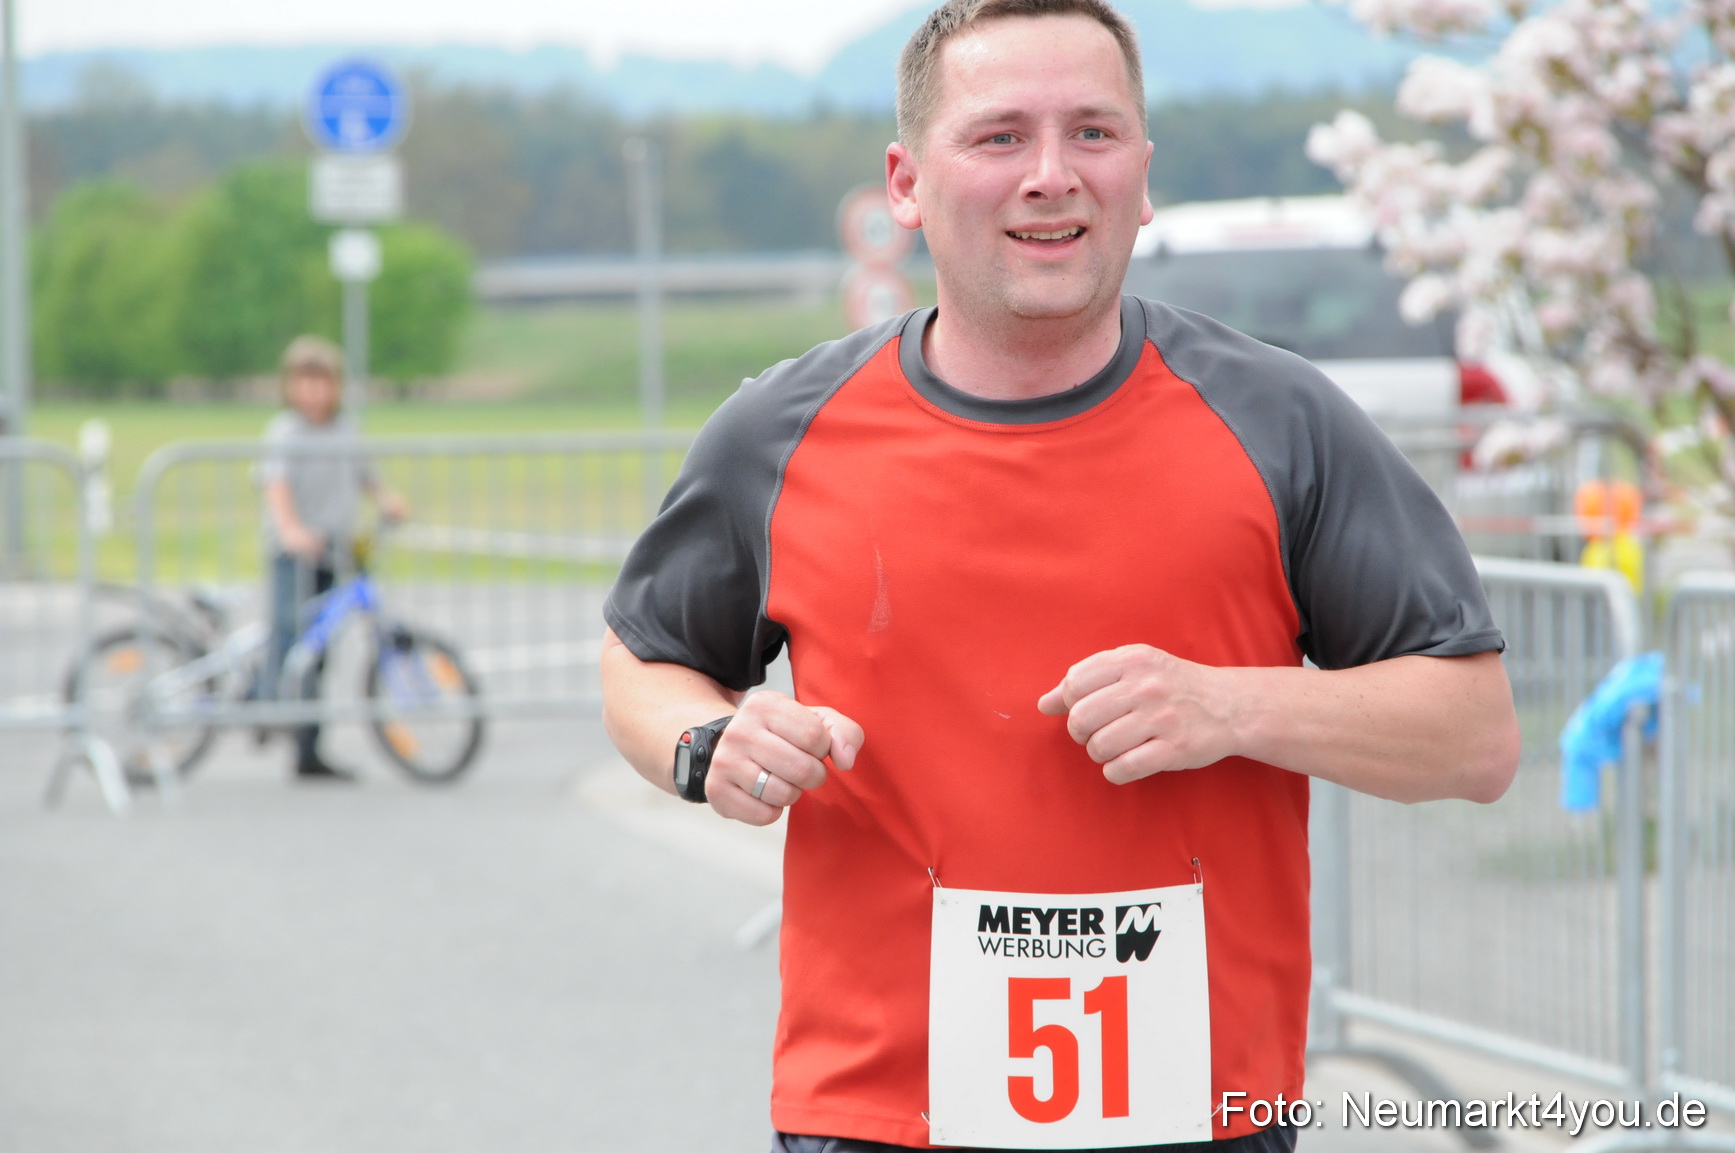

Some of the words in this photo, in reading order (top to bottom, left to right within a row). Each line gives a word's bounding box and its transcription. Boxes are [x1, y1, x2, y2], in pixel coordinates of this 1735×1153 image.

[977, 904, 1105, 936] MEYER
[977, 936, 1107, 959] WERBUNG
[1007, 975, 1130, 1124] 51
